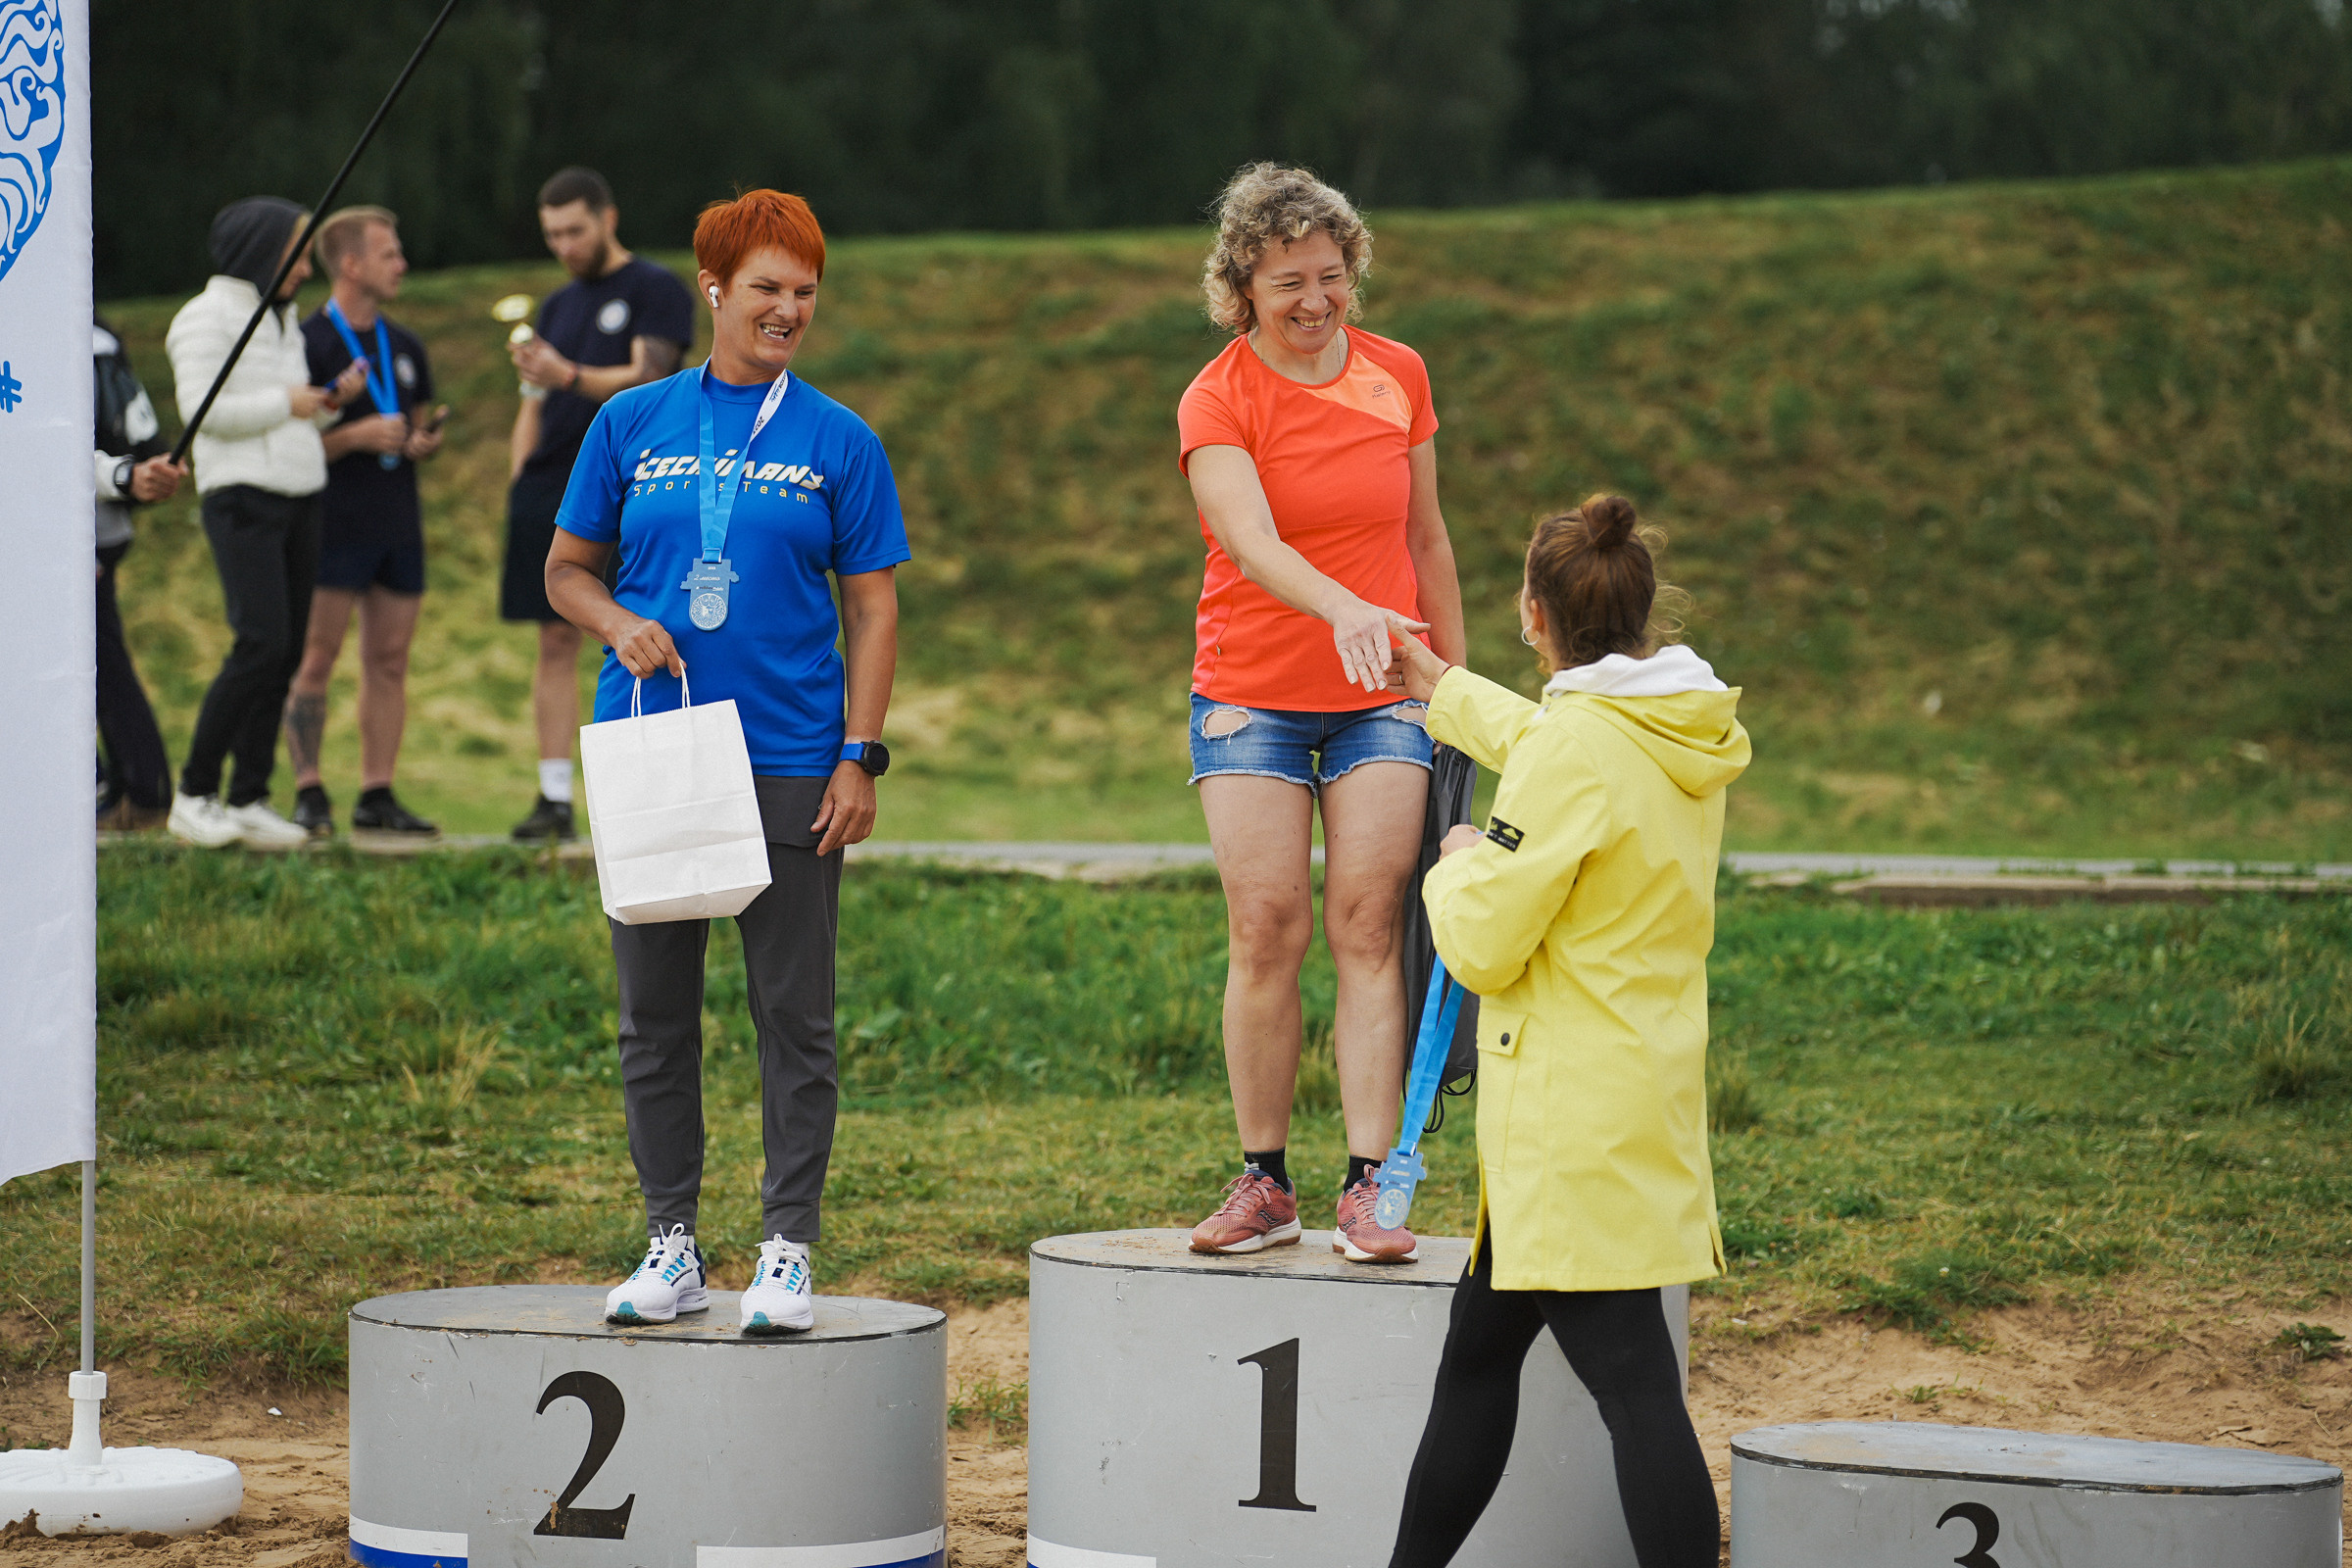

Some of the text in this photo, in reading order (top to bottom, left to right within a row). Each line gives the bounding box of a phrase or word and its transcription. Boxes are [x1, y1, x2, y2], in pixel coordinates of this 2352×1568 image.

[633, 479, 809, 505] Spors Team
[533, 1370, 636, 1540] 2
[1237, 1338, 1317, 1513] 1
[1936, 1501, 2001, 1568] 3
